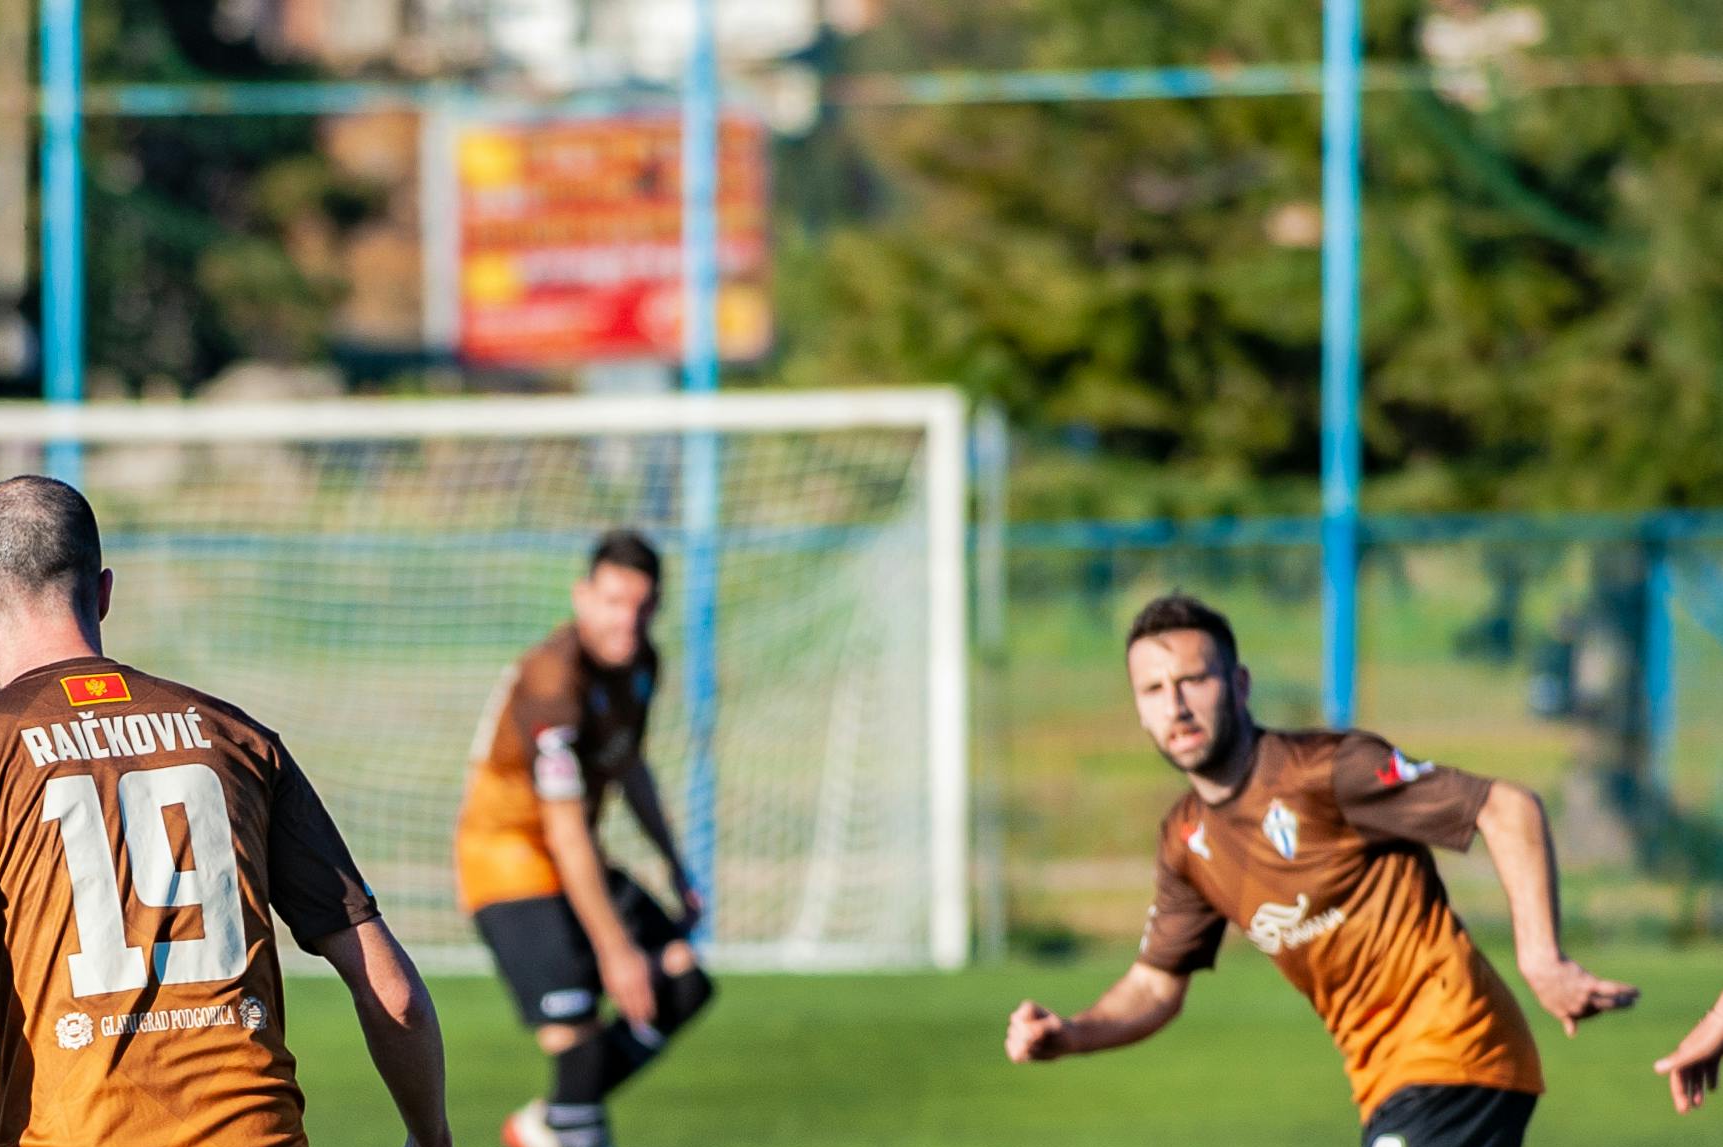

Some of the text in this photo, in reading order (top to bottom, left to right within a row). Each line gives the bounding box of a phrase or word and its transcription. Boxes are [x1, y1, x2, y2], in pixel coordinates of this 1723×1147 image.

[20, 707, 212, 768] RAIČKOVIĆ
[41, 763, 248, 998] 19
[139, 1010, 170, 1034] GRAD
[171, 1005, 236, 1030] PODGORICA
